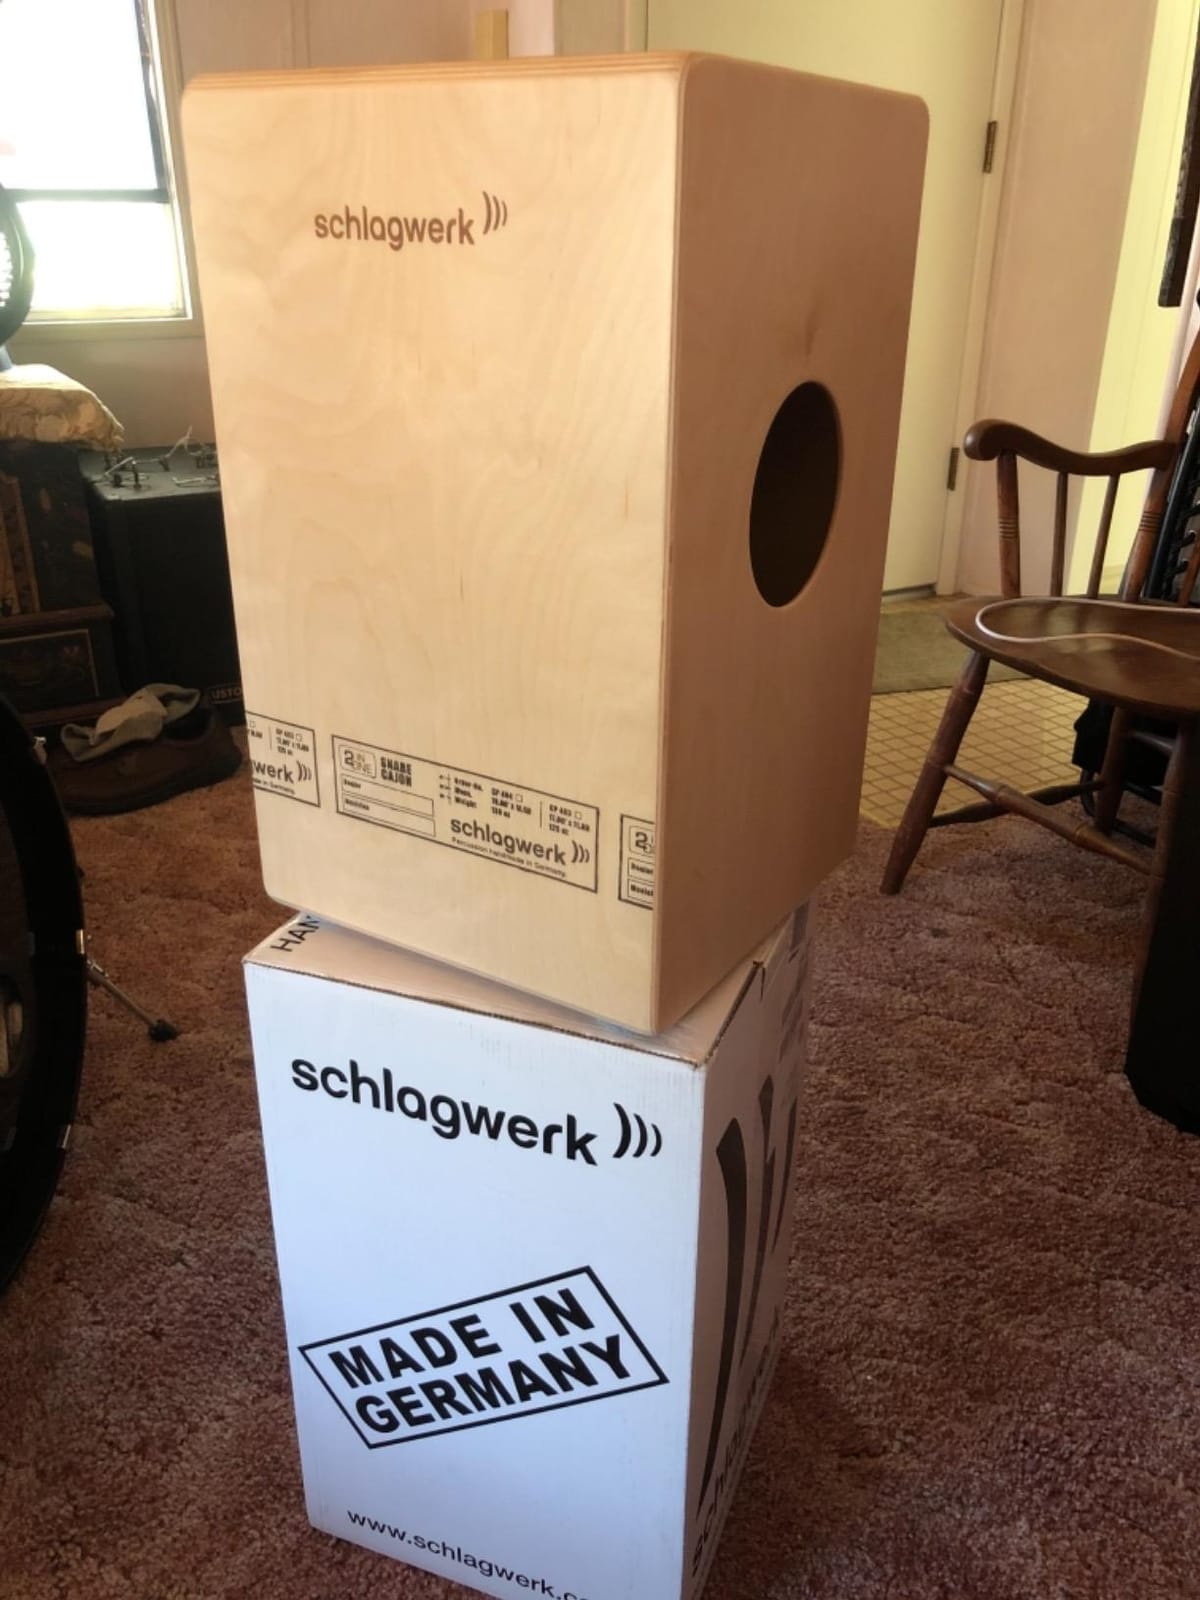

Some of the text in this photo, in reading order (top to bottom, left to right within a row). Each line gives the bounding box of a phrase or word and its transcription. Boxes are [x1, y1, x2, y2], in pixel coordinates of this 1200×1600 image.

[314, 204, 475, 251] schlagwerk
[344, 749, 354, 767] 2
[450, 819, 566, 866] schlagwerk
[635, 831, 648, 850] 2
[270, 915, 320, 953] HAN
[291, 1058, 598, 1167] schlagwerk
[328, 1287, 595, 1389] MADE IN
[355, 1334, 631, 1434] GERMANY
